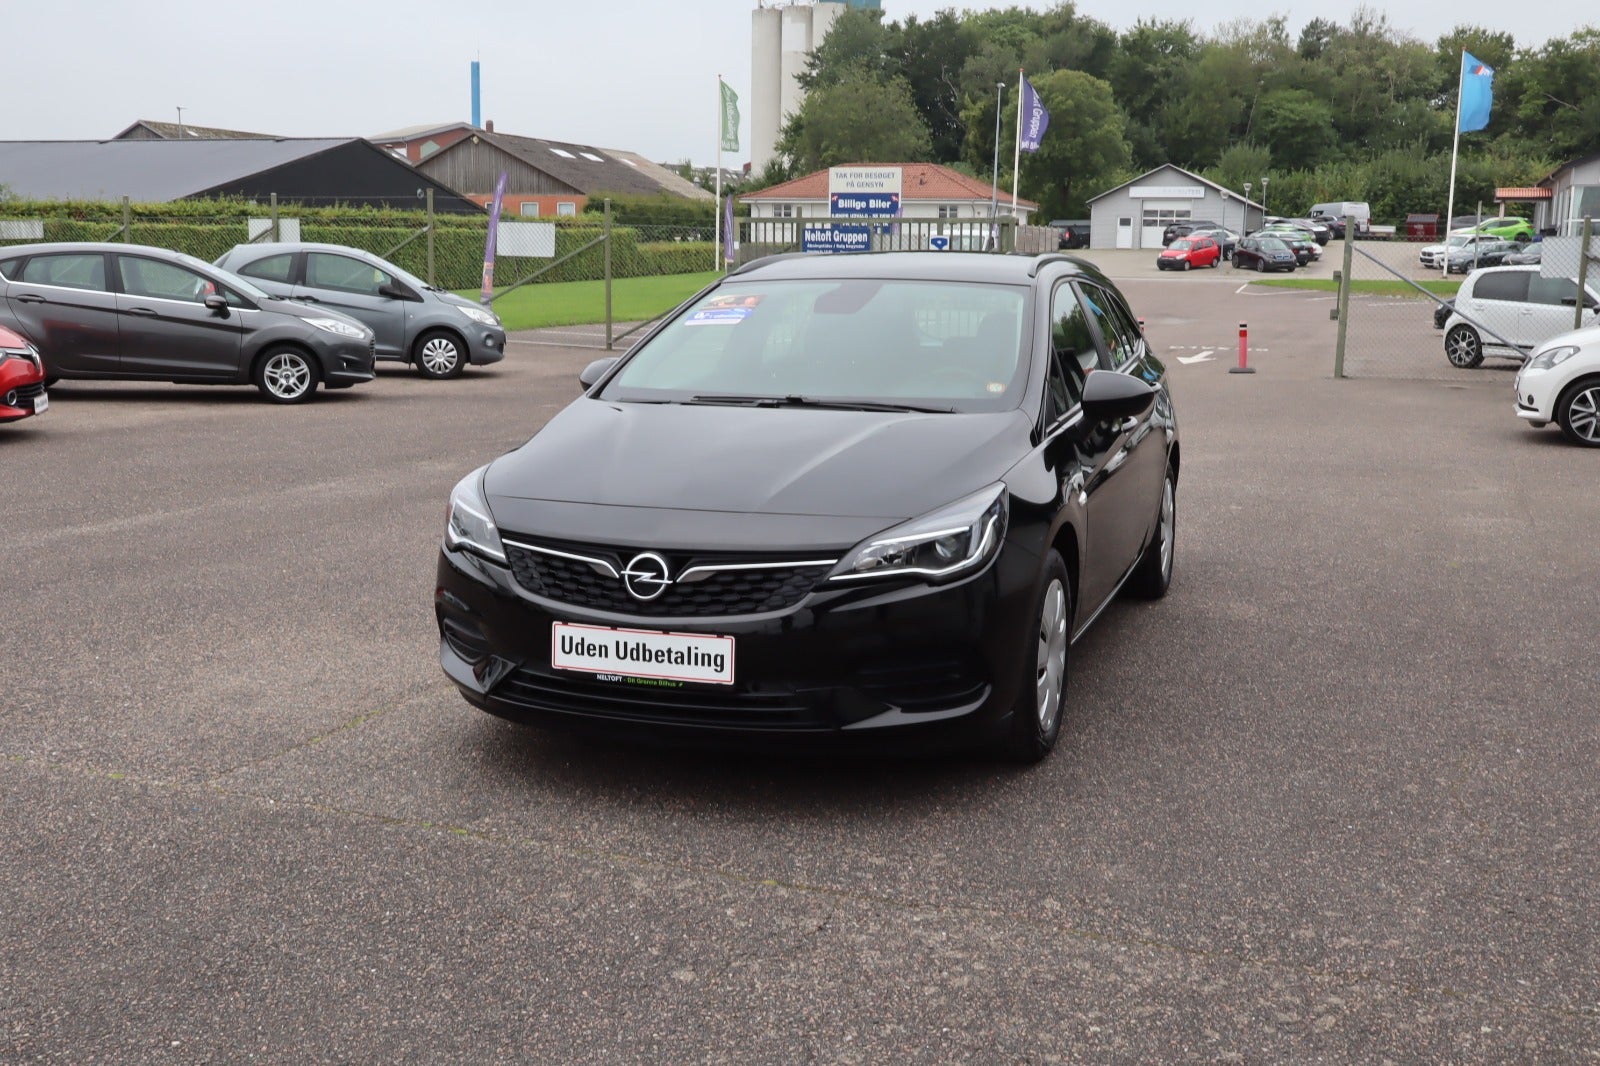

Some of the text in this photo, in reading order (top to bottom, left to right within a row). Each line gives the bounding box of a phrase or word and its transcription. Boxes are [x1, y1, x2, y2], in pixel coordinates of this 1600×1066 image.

[838, 199, 892, 210] Billige Biler
[804, 230, 868, 244] Neltoft Gruppen
[561, 635, 724, 672] Uden Udbetaling
[596, 674, 622, 682] NELTOFT
